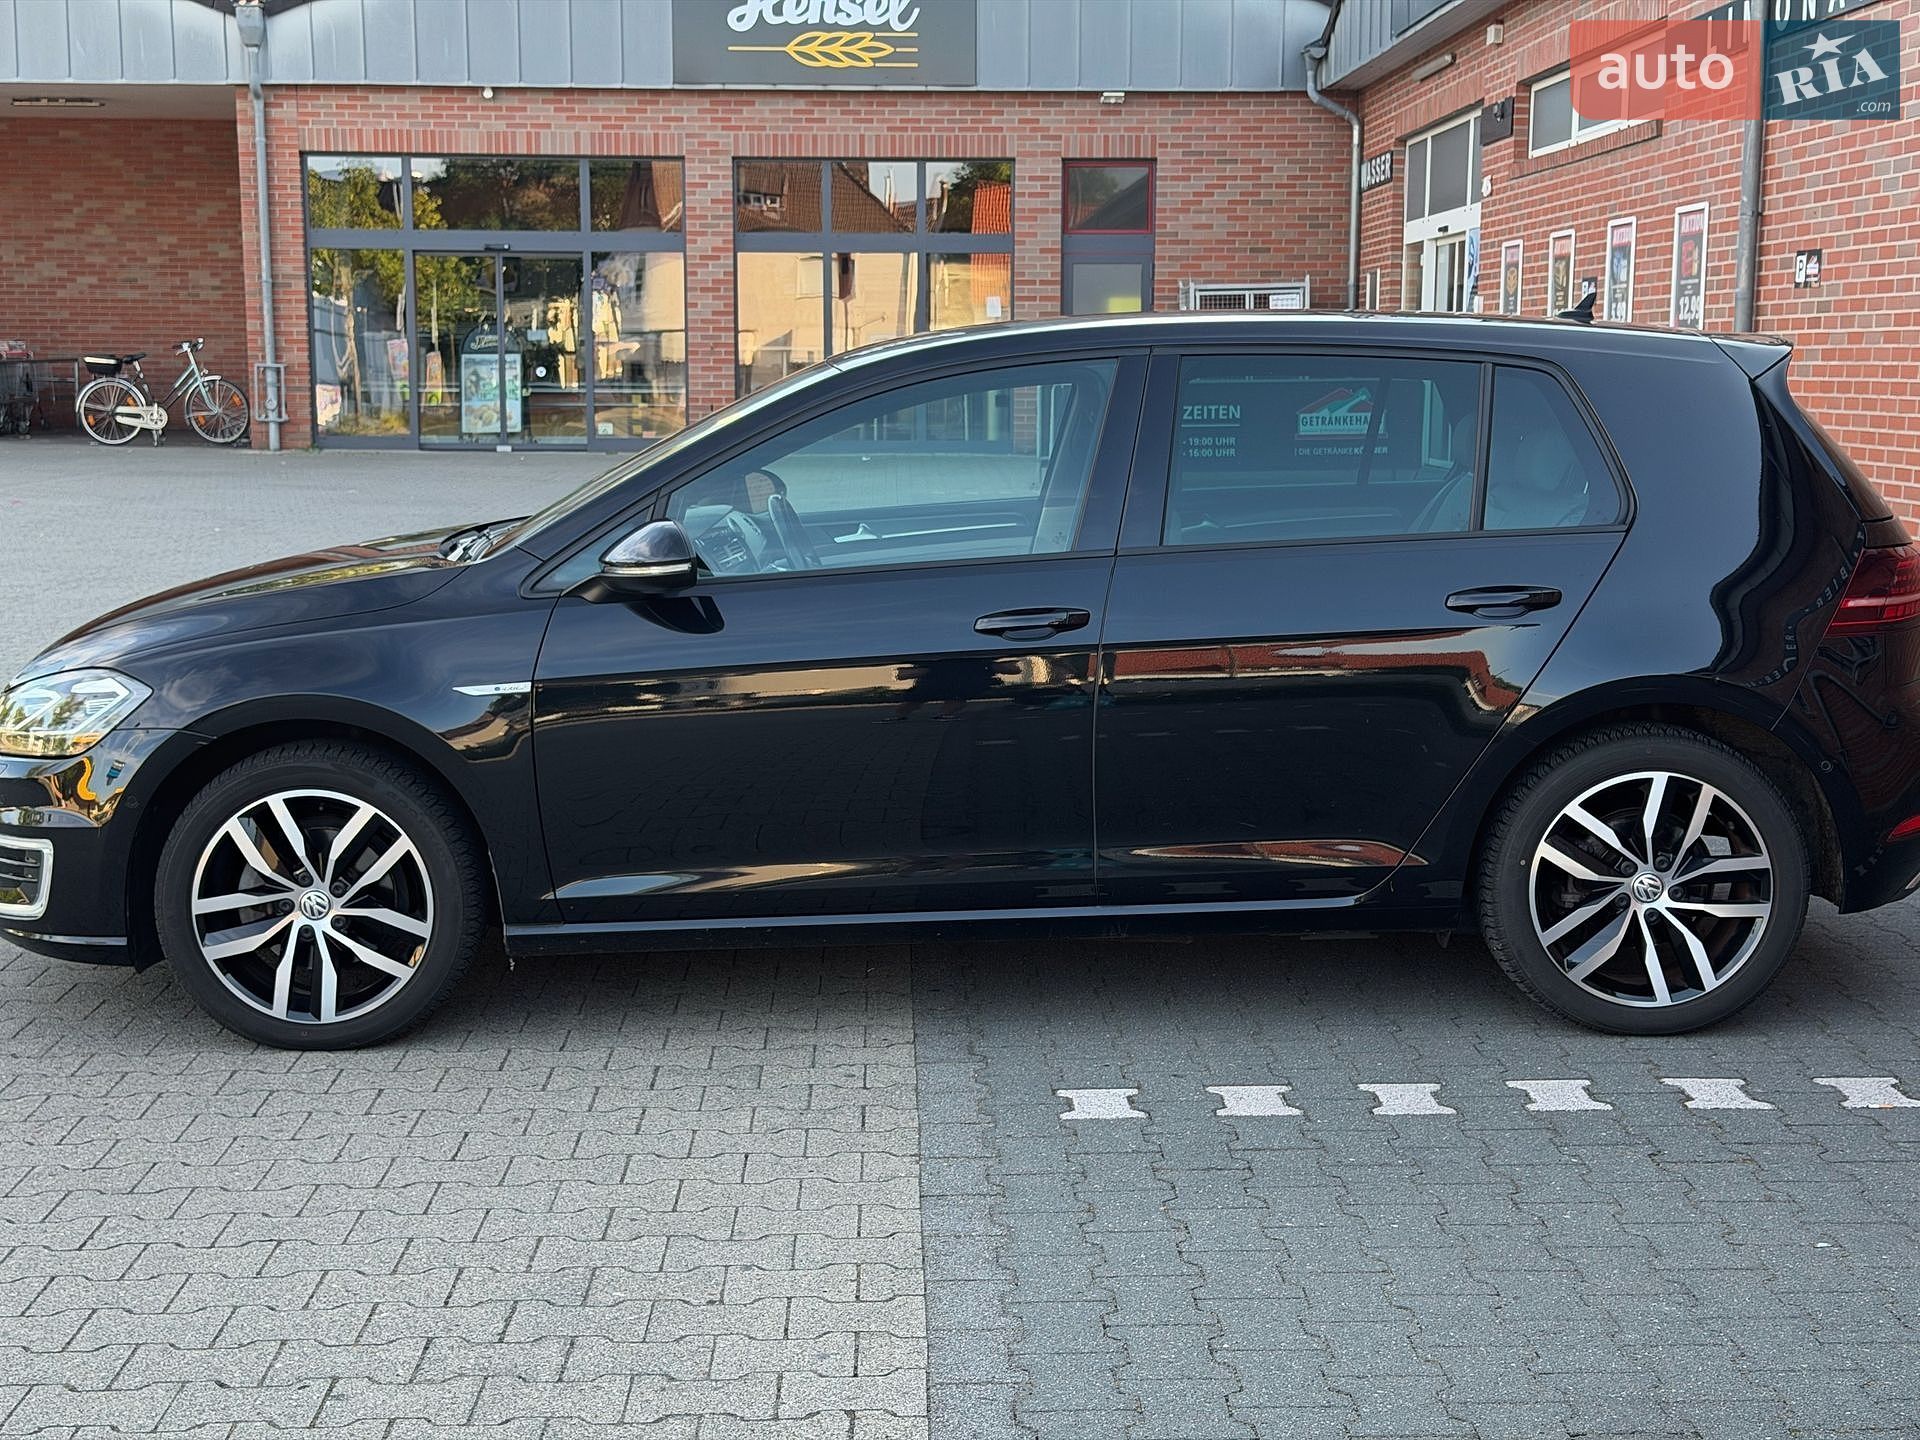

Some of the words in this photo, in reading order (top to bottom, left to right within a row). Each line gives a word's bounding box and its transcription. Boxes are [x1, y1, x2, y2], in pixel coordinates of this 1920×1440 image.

[1182, 405, 1241, 420] ZEITEN
[1188, 437, 1214, 447] 19:00
[1216, 437, 1236, 446] UHR
